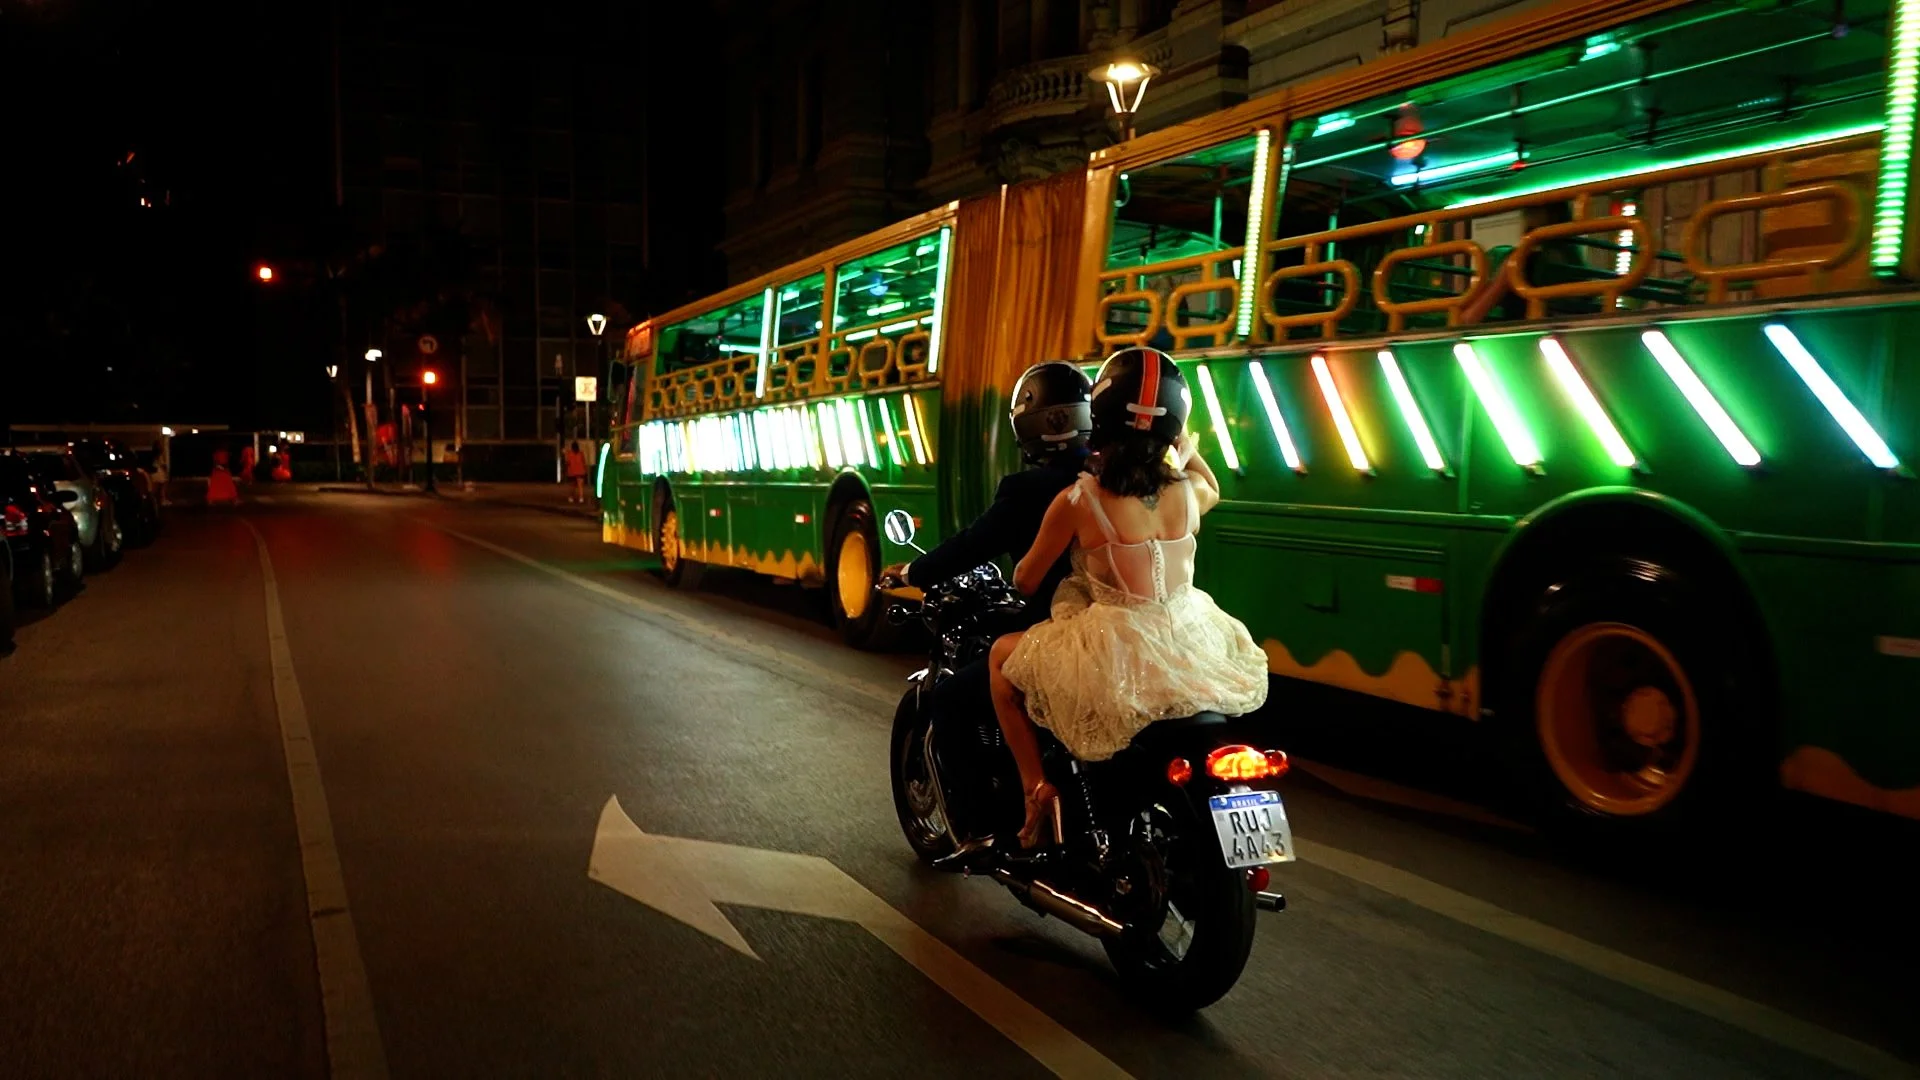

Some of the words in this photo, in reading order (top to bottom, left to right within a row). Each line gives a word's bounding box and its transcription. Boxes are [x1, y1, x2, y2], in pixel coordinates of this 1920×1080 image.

[1231, 799, 1258, 808] BRASIL
[1229, 808, 1271, 835] RUJ
[1233, 833, 1284, 860] 4A43
